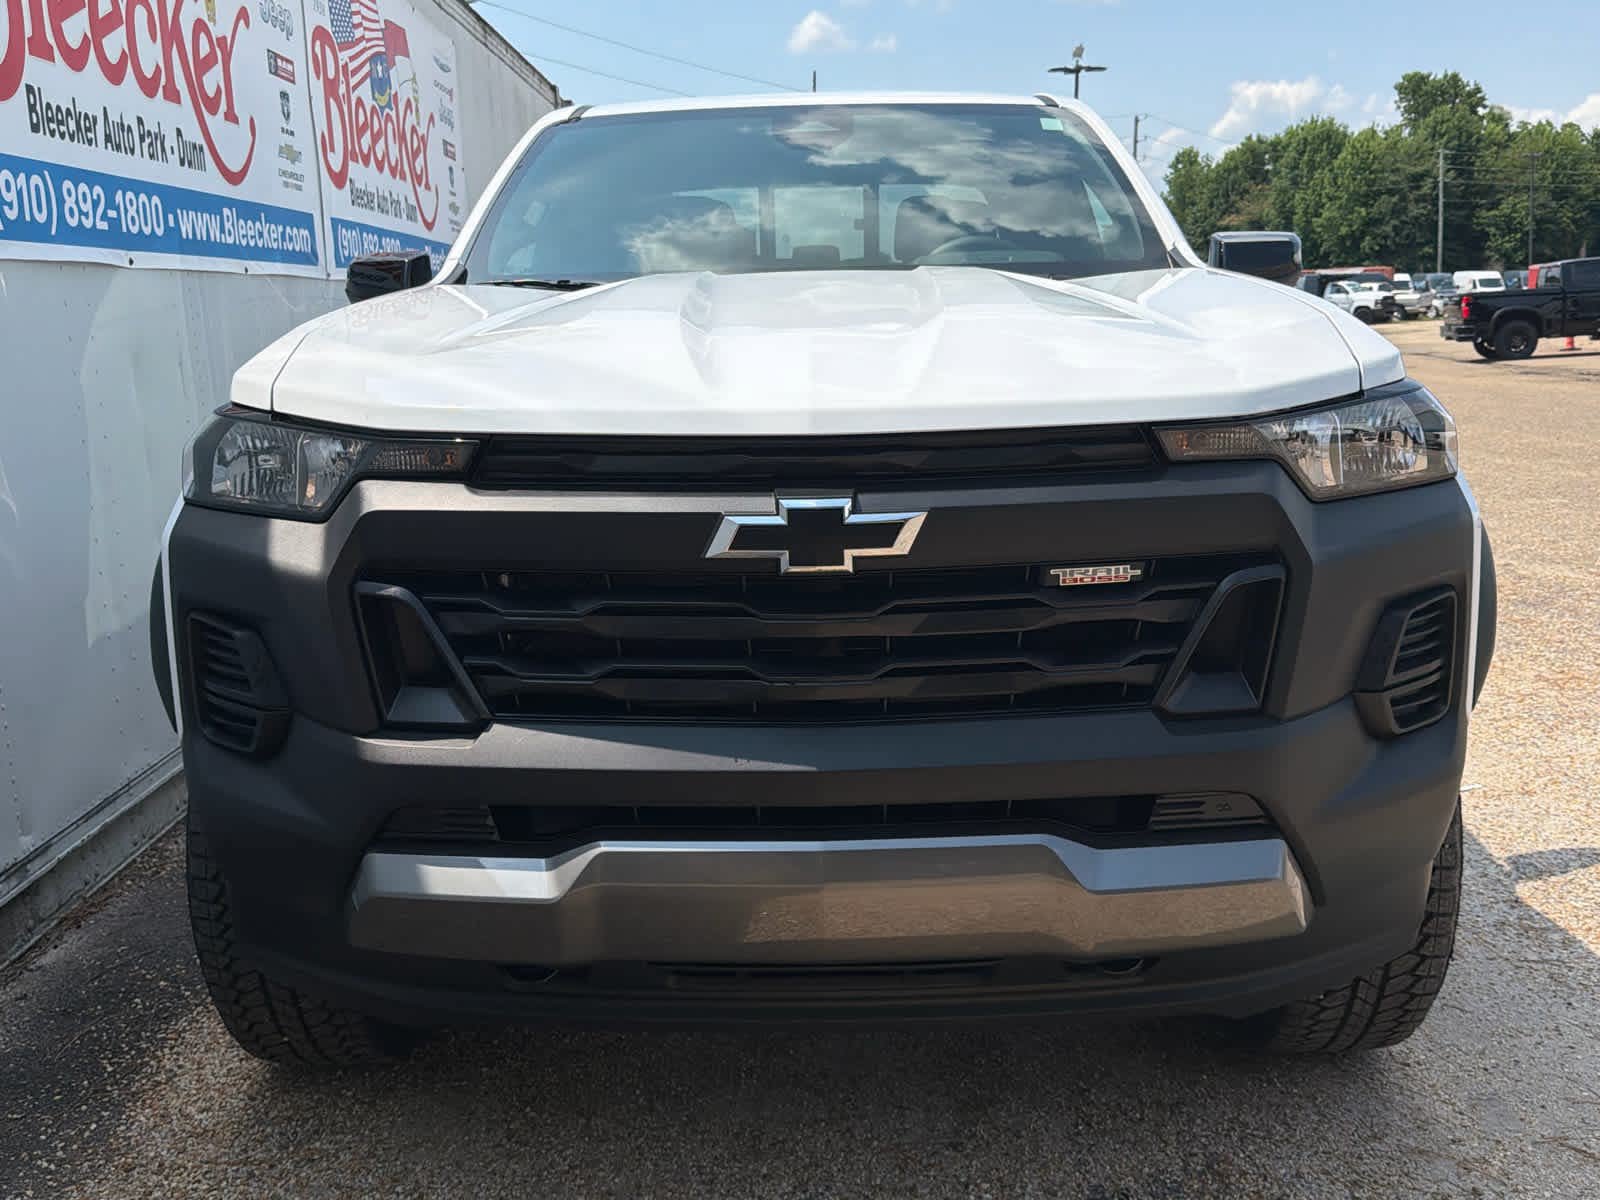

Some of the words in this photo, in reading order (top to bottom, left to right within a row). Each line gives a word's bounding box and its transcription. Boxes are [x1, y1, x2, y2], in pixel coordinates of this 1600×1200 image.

[25, 83, 98, 147] Bleecker
[103, 106, 135, 157] Auto
[136, 115, 168, 163] Park
[176, 127, 207, 172] Dunn
[280, 127, 296, 137] RAM
[311, 25, 439, 232] Bleecker
[0, 169, 57, 235] 910)
[62, 179, 165, 237] 892-1800
[177, 207, 312, 254] www.Bleecker.com
[349, 177, 376, 212] Bleecker
[338, 223, 362, 263] (910)
[1050, 565, 1141, 577] TRAIL
